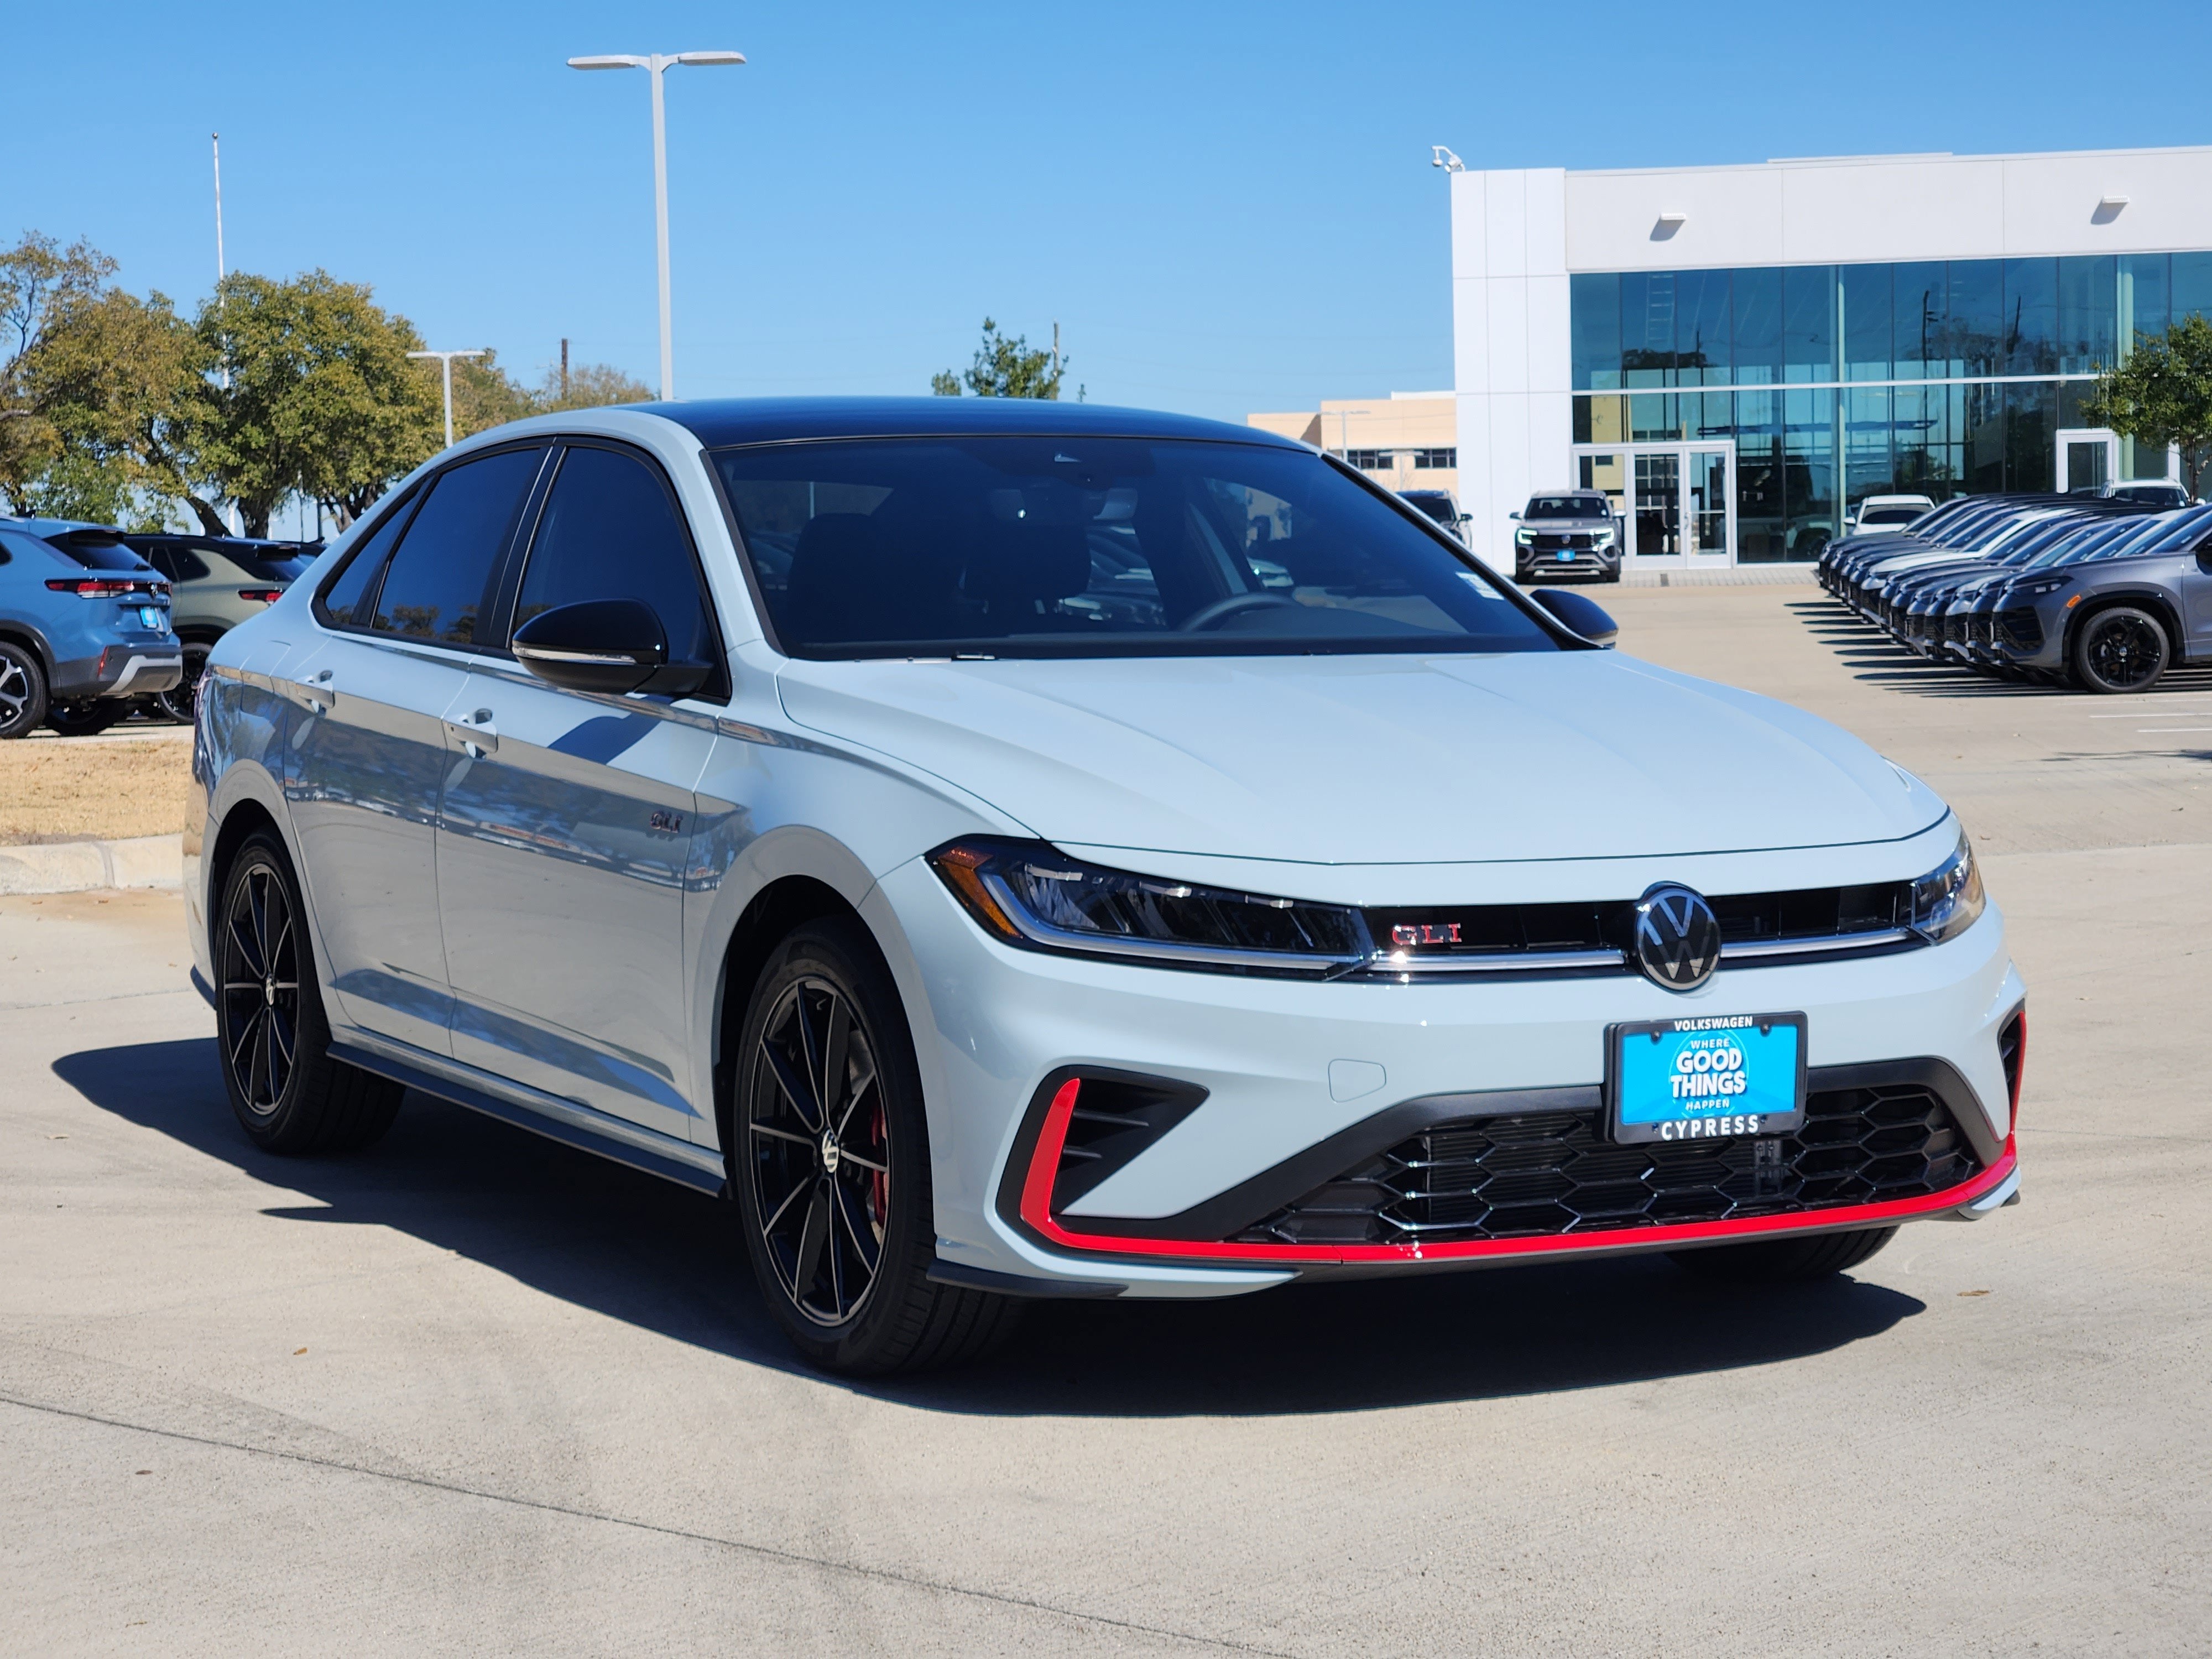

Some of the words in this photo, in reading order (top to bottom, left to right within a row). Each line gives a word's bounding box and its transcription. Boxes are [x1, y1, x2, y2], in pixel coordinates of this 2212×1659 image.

[1392, 923, 1462, 946] GLI
[1674, 1016, 1753, 1031] VOLKSWAGEN
[1691, 1038, 1730, 1050] WHERE
[1676, 1048, 1743, 1073] GOOD
[1670, 1071, 1746, 1098] THINGS
[1686, 1098, 1730, 1110] HAPPEN
[1661, 1115, 1759, 1140] CYPRESS
